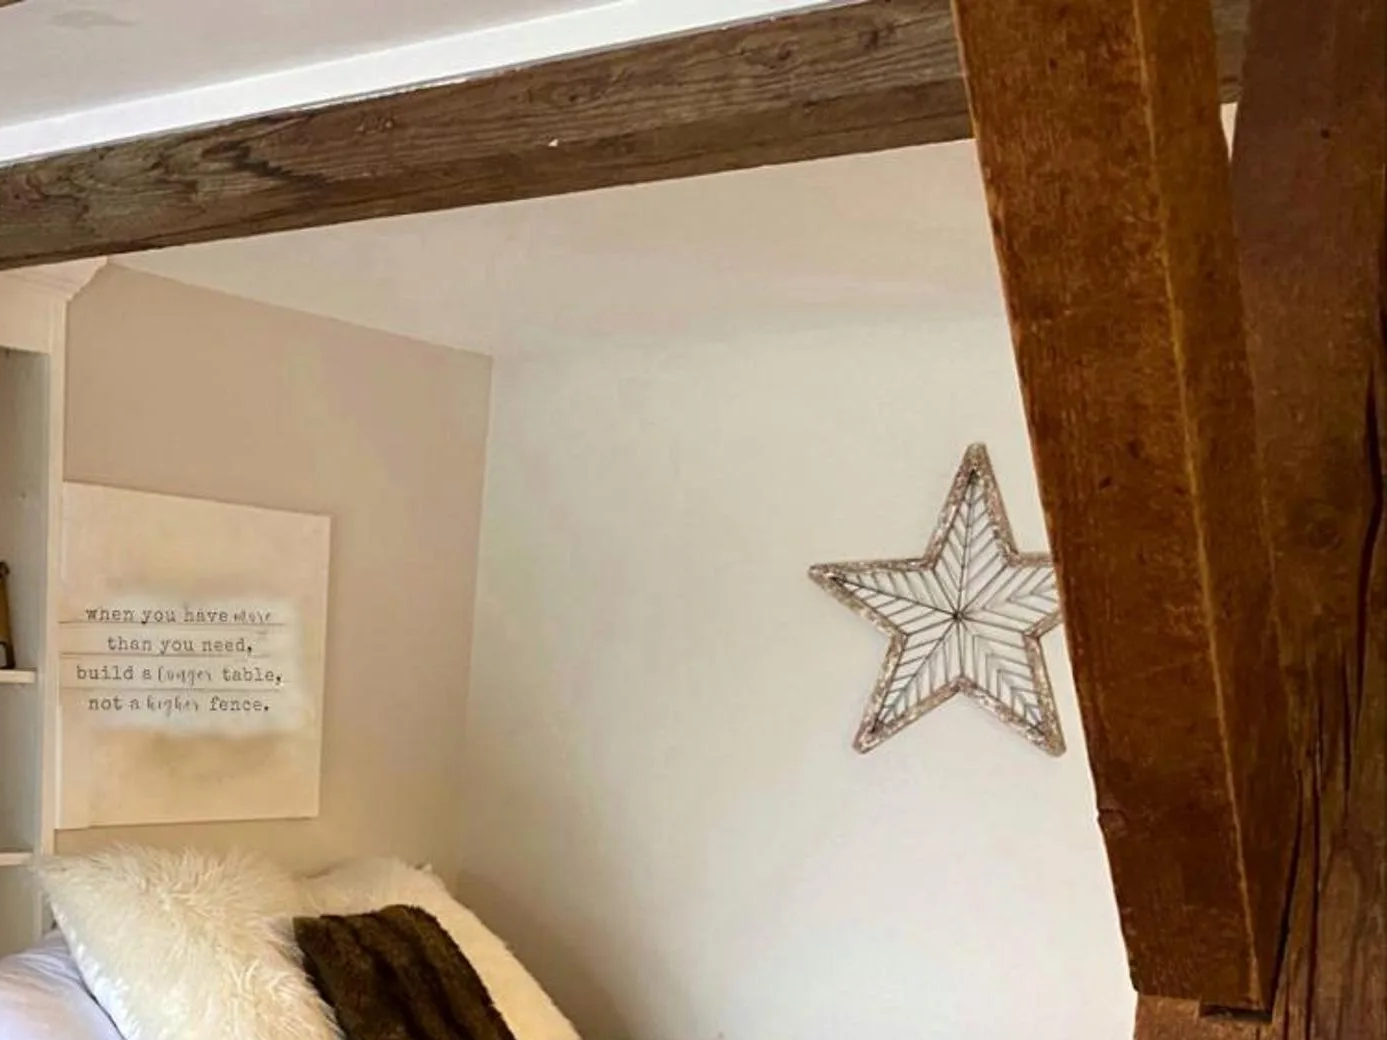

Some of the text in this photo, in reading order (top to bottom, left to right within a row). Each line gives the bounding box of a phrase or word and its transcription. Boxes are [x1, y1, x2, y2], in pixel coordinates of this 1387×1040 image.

[85, 608, 136, 622] when
[142, 611, 176, 624] you
[184, 606, 228, 623] have
[107, 635, 253, 656] than you need,
[76, 665, 134, 682] build
[222, 667, 283, 684] table,
[88, 695, 123, 711] not
[130, 698, 141, 711] a
[209, 697, 270, 713] fence.
